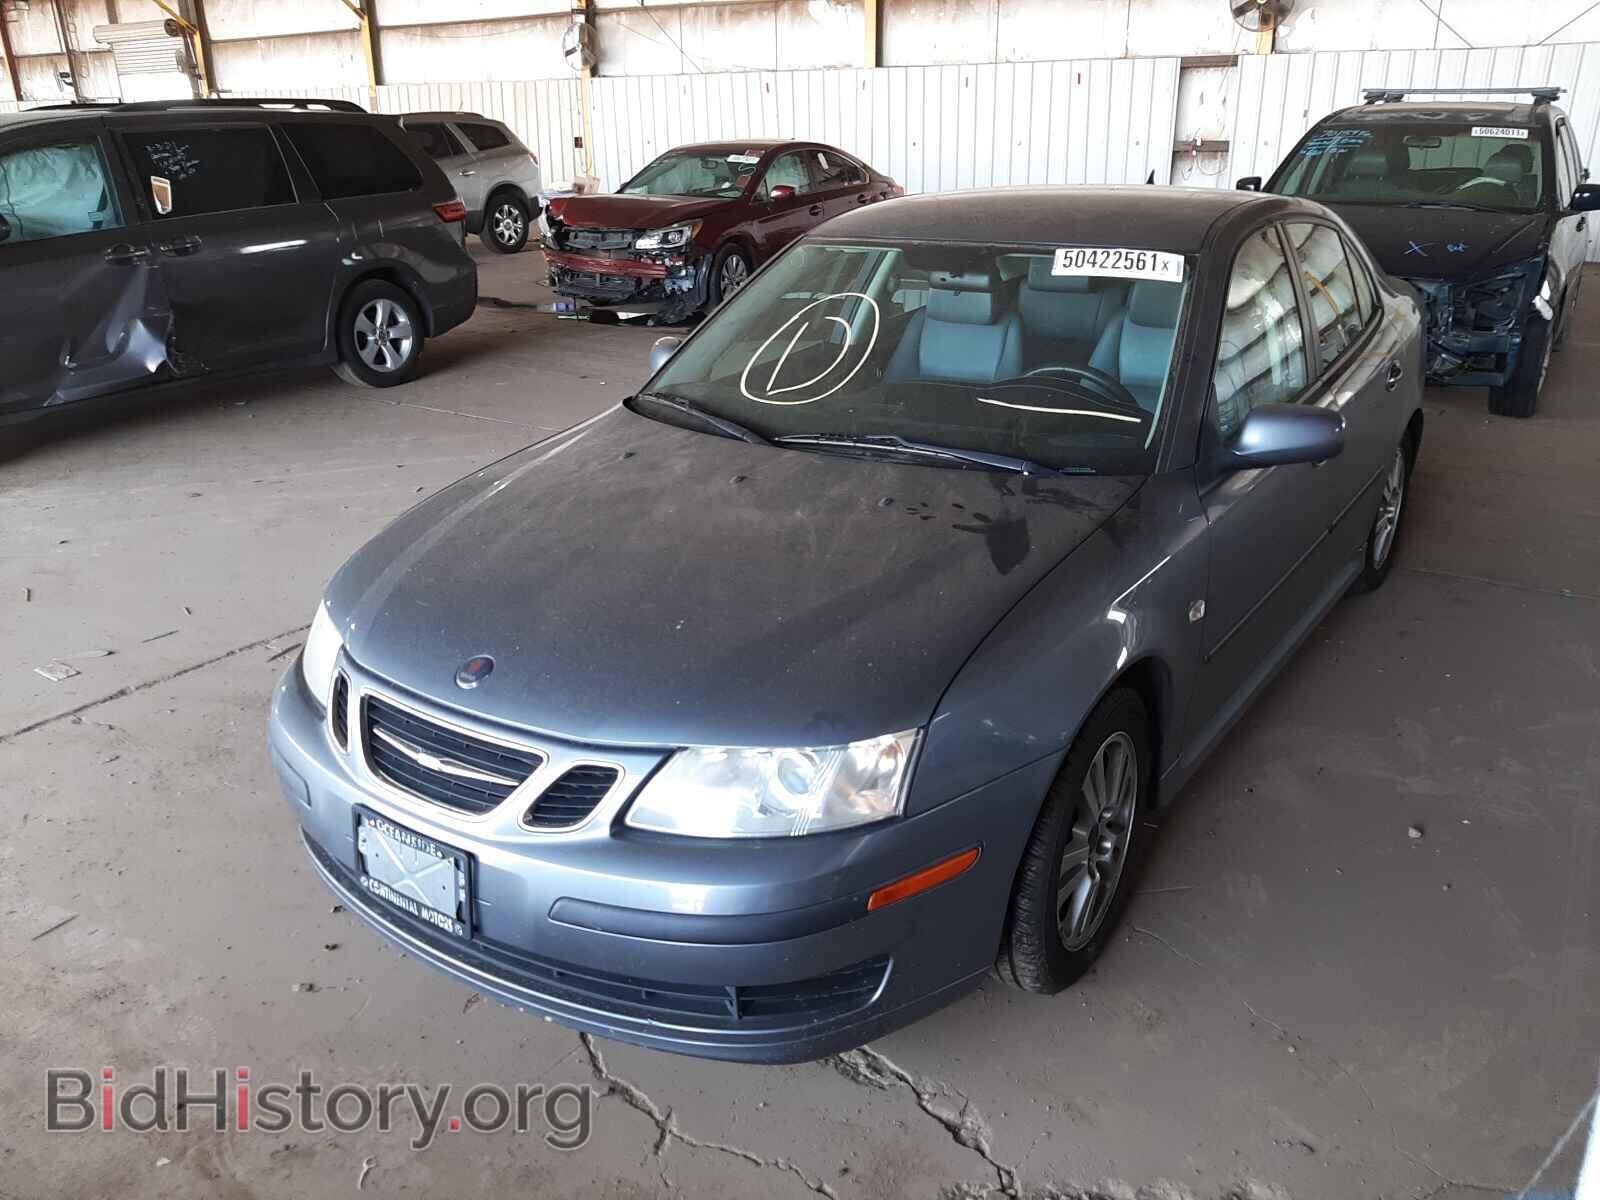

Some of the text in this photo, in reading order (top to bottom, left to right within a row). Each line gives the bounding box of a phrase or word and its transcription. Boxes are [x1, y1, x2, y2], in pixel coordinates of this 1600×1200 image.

[376, 820, 438, 856] OCEANSIDE
[369, 878, 453, 933] CONTINENTAL MOTORS
